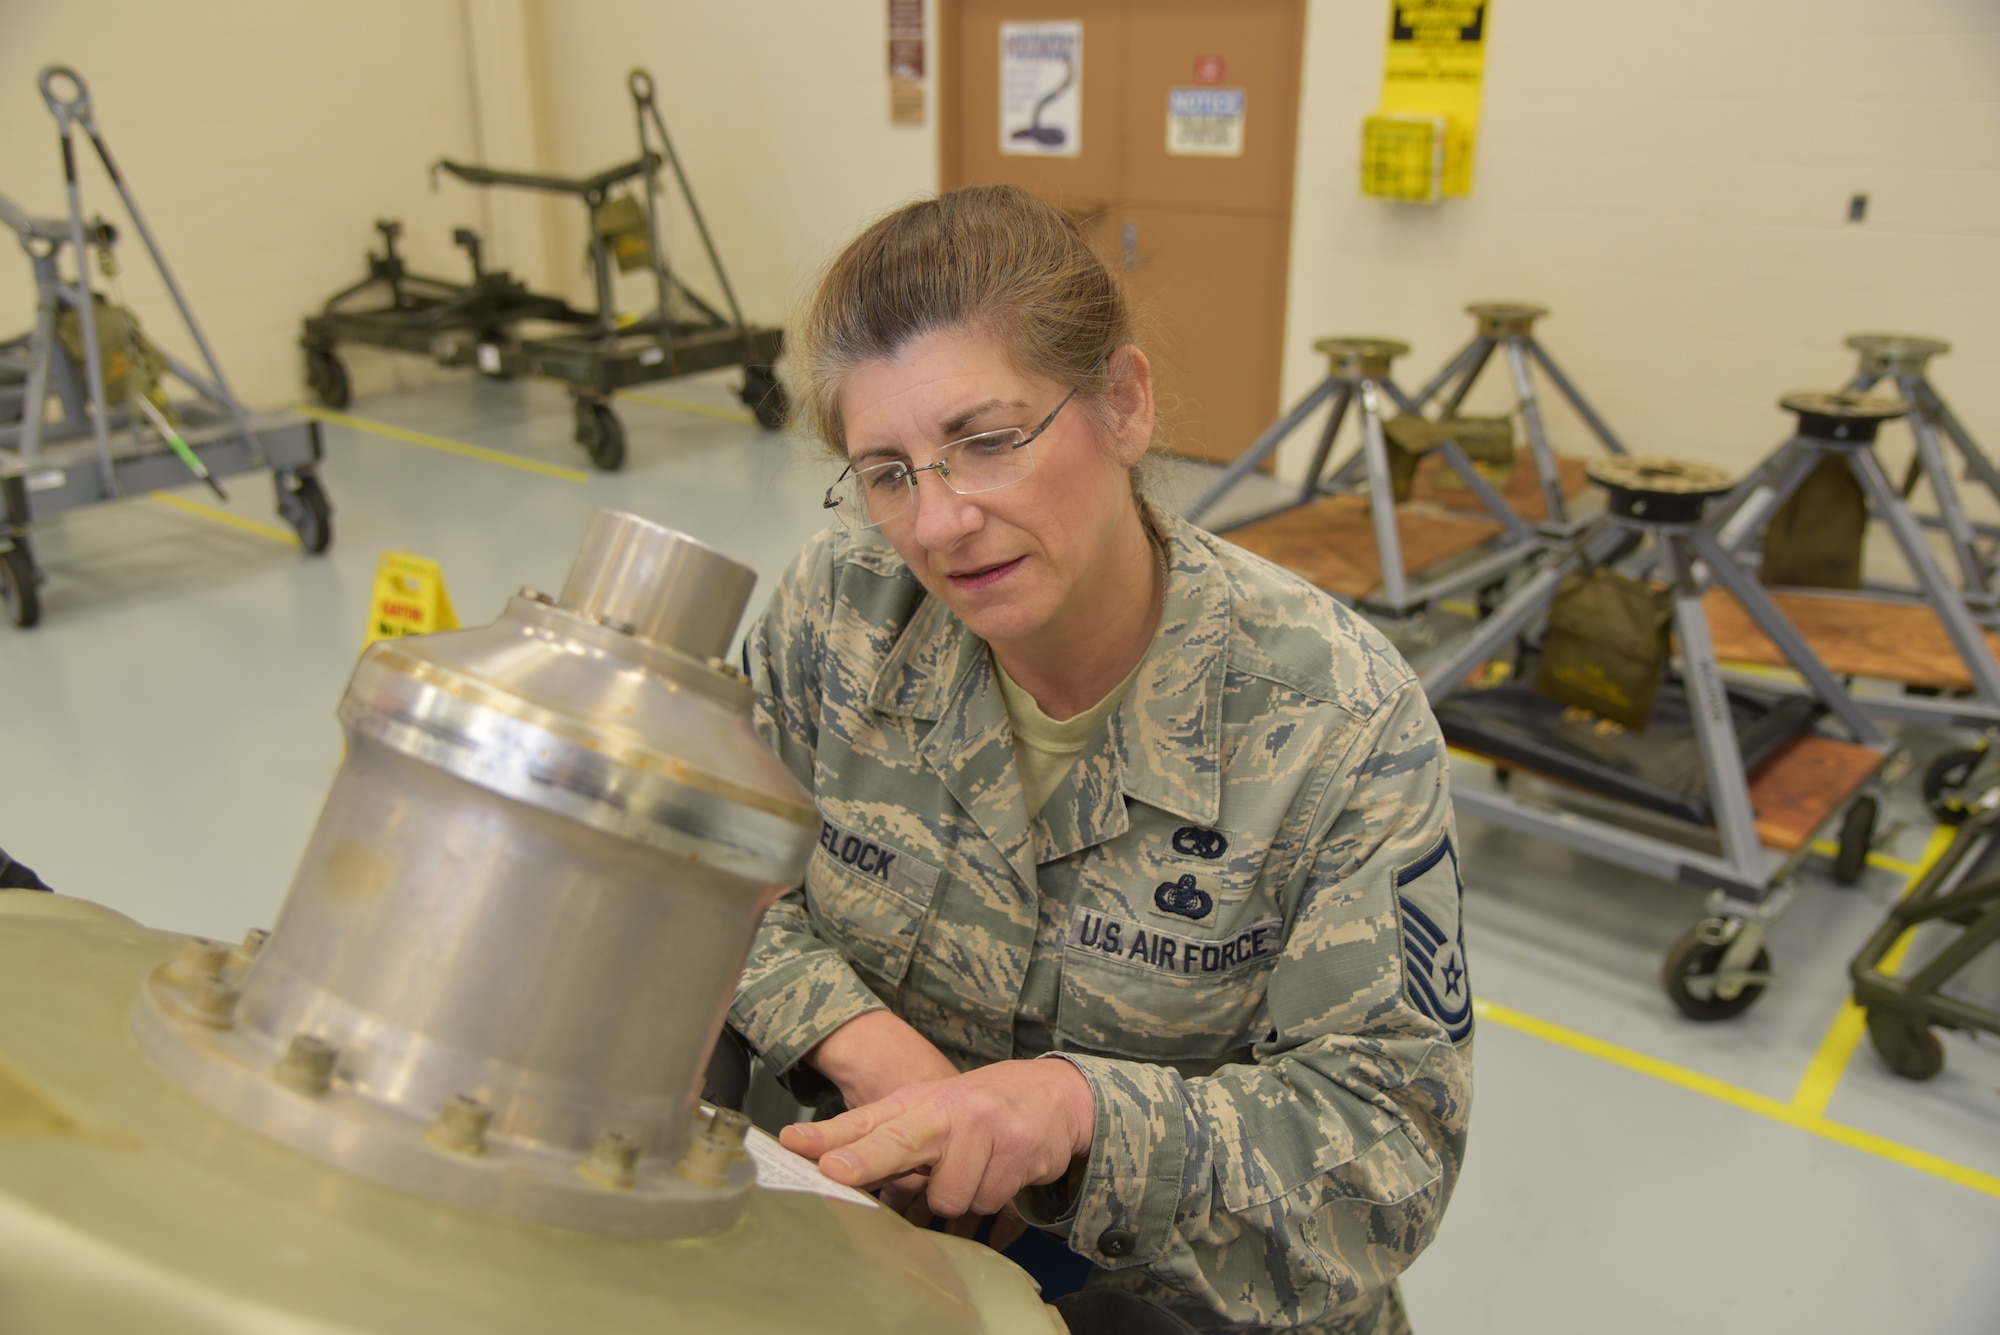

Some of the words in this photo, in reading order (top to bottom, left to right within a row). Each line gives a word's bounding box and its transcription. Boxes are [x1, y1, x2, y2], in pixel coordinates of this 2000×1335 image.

[1172, 91, 1242, 115] NOTICE
[1080, 914, 1122, 955] U.S.
[1128, 930, 1176, 970] AIR
[1184, 927, 1268, 973] FORCE
